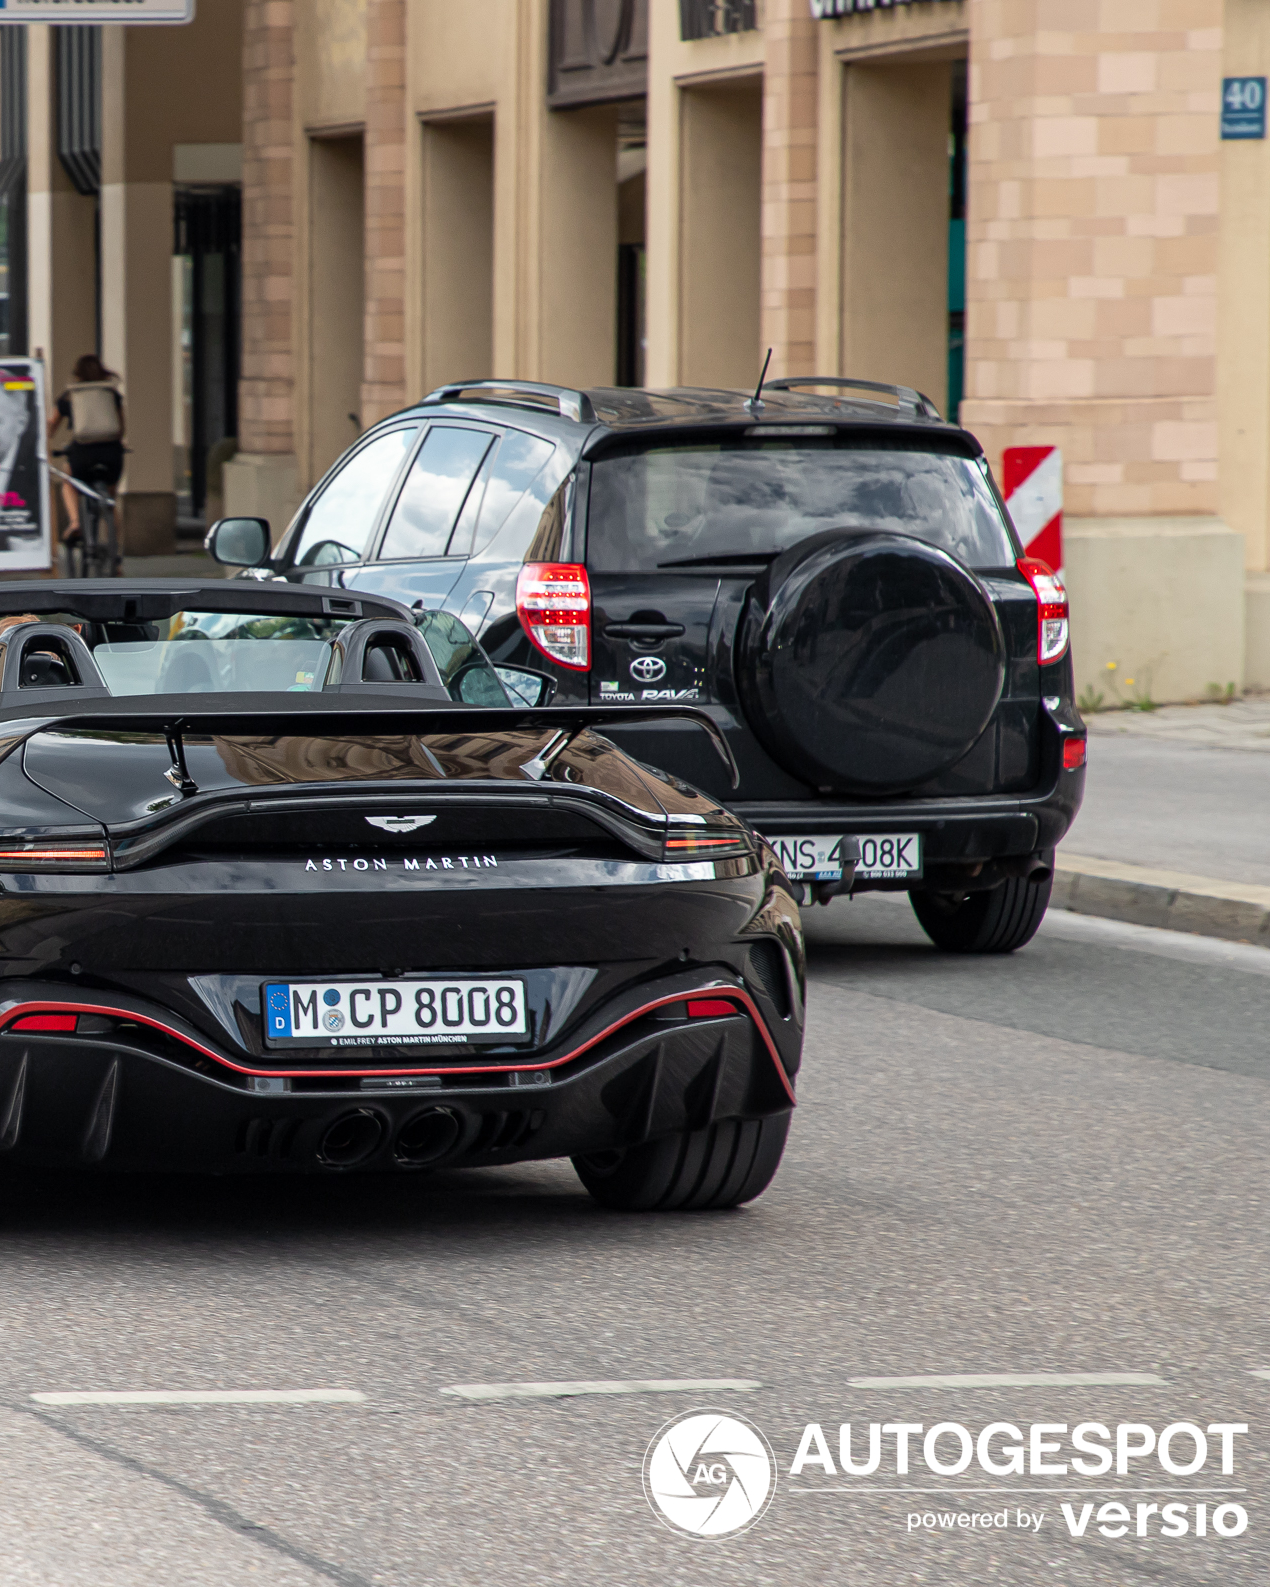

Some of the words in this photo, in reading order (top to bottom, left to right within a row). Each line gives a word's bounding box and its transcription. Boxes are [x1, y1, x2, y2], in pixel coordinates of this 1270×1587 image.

[1226, 81, 1262, 109] 40
[600, 692, 635, 701] TOYOTA
[641, 688, 700, 701] RAV4
[305, 858, 388, 872] ASTON
[404, 855, 498, 871] MARTIN
[827, 837, 914, 869] 408K
[293, 989, 319, 1030] M
[349, 988, 402, 1029] CP
[414, 986, 518, 1029] 8008
[377, 1036, 401, 1044] ASTON
[403, 1036, 430, 1044] MARTIN
[431, 1034, 467, 1043] MÜNCHEN
